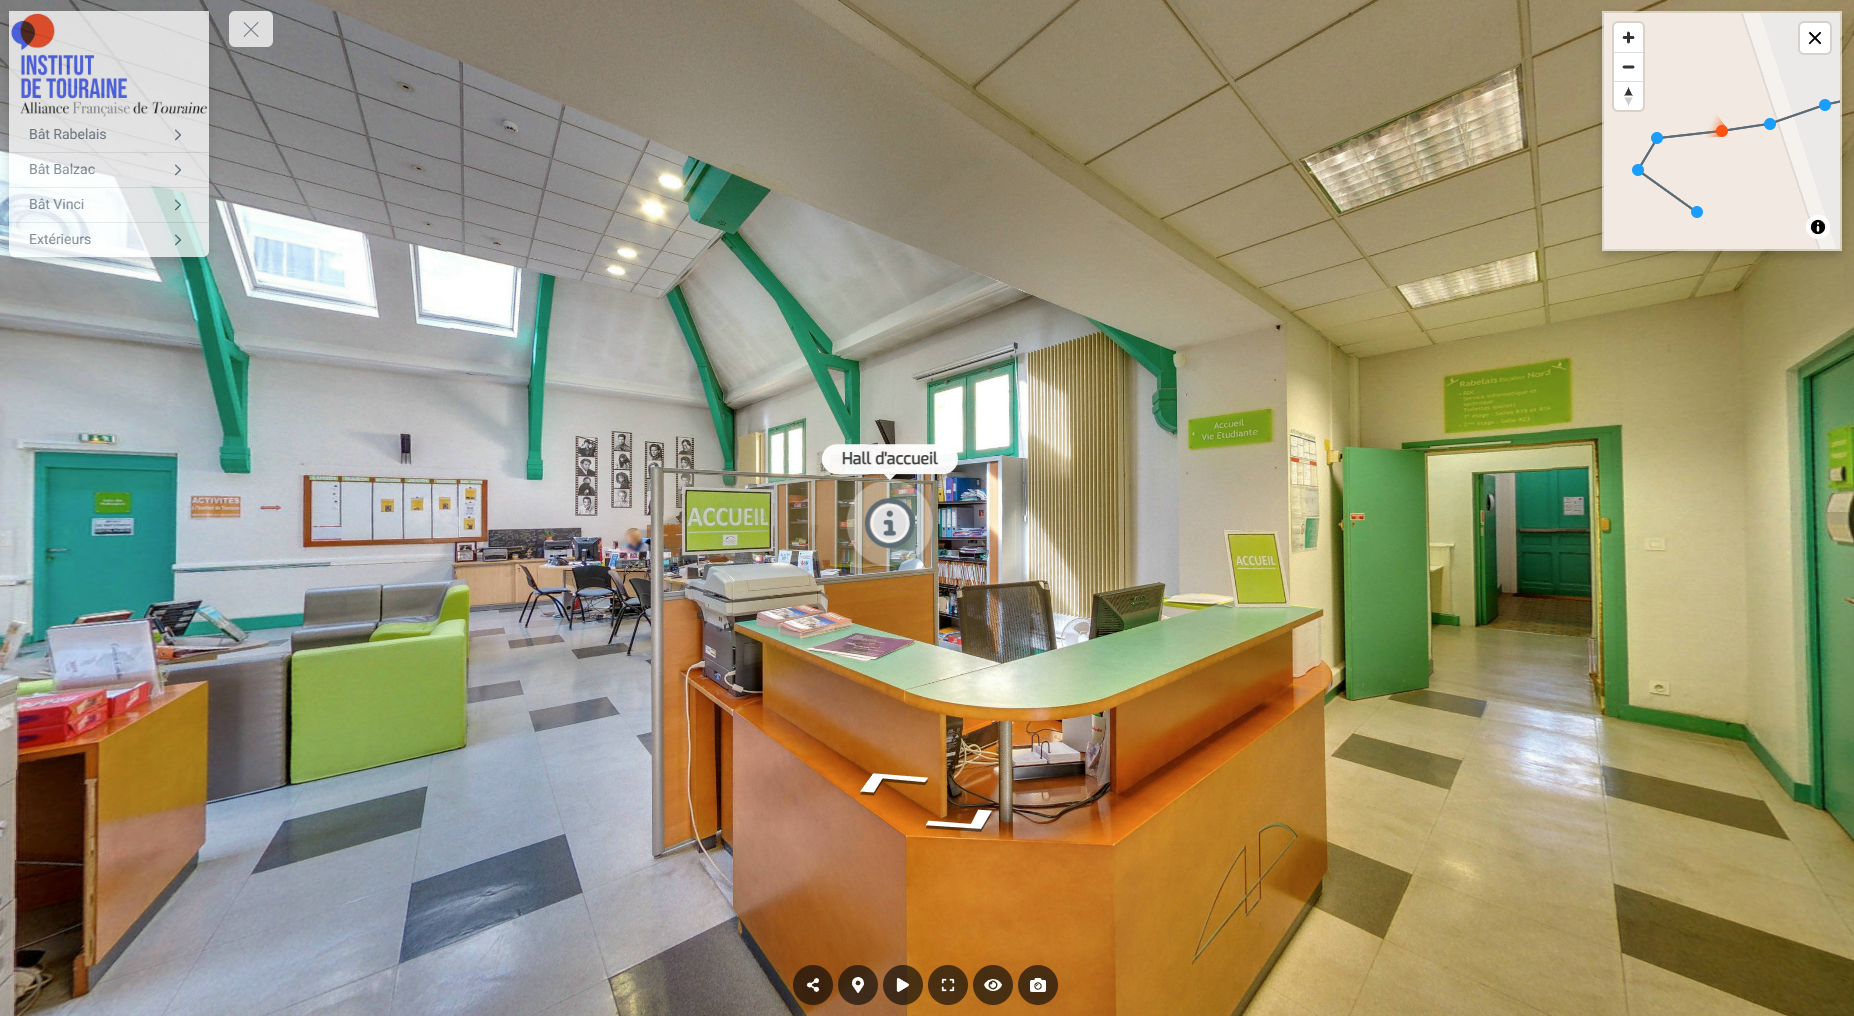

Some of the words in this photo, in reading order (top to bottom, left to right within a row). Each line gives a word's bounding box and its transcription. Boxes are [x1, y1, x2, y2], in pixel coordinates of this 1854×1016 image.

[1459, 377, 1498, 388] Rabelais
[1527, 368, 1552, 379] Nord
[1213, 419, 1244, 430] Accueil
[1201, 433, 1215, 441] Vie
[1216, 429, 1259, 440] Etudiante
[191, 496, 240, 504] ACTIVITES
[687, 506, 770, 527] ACCUEIL
[1235, 555, 1277, 566] ACCUEIL
